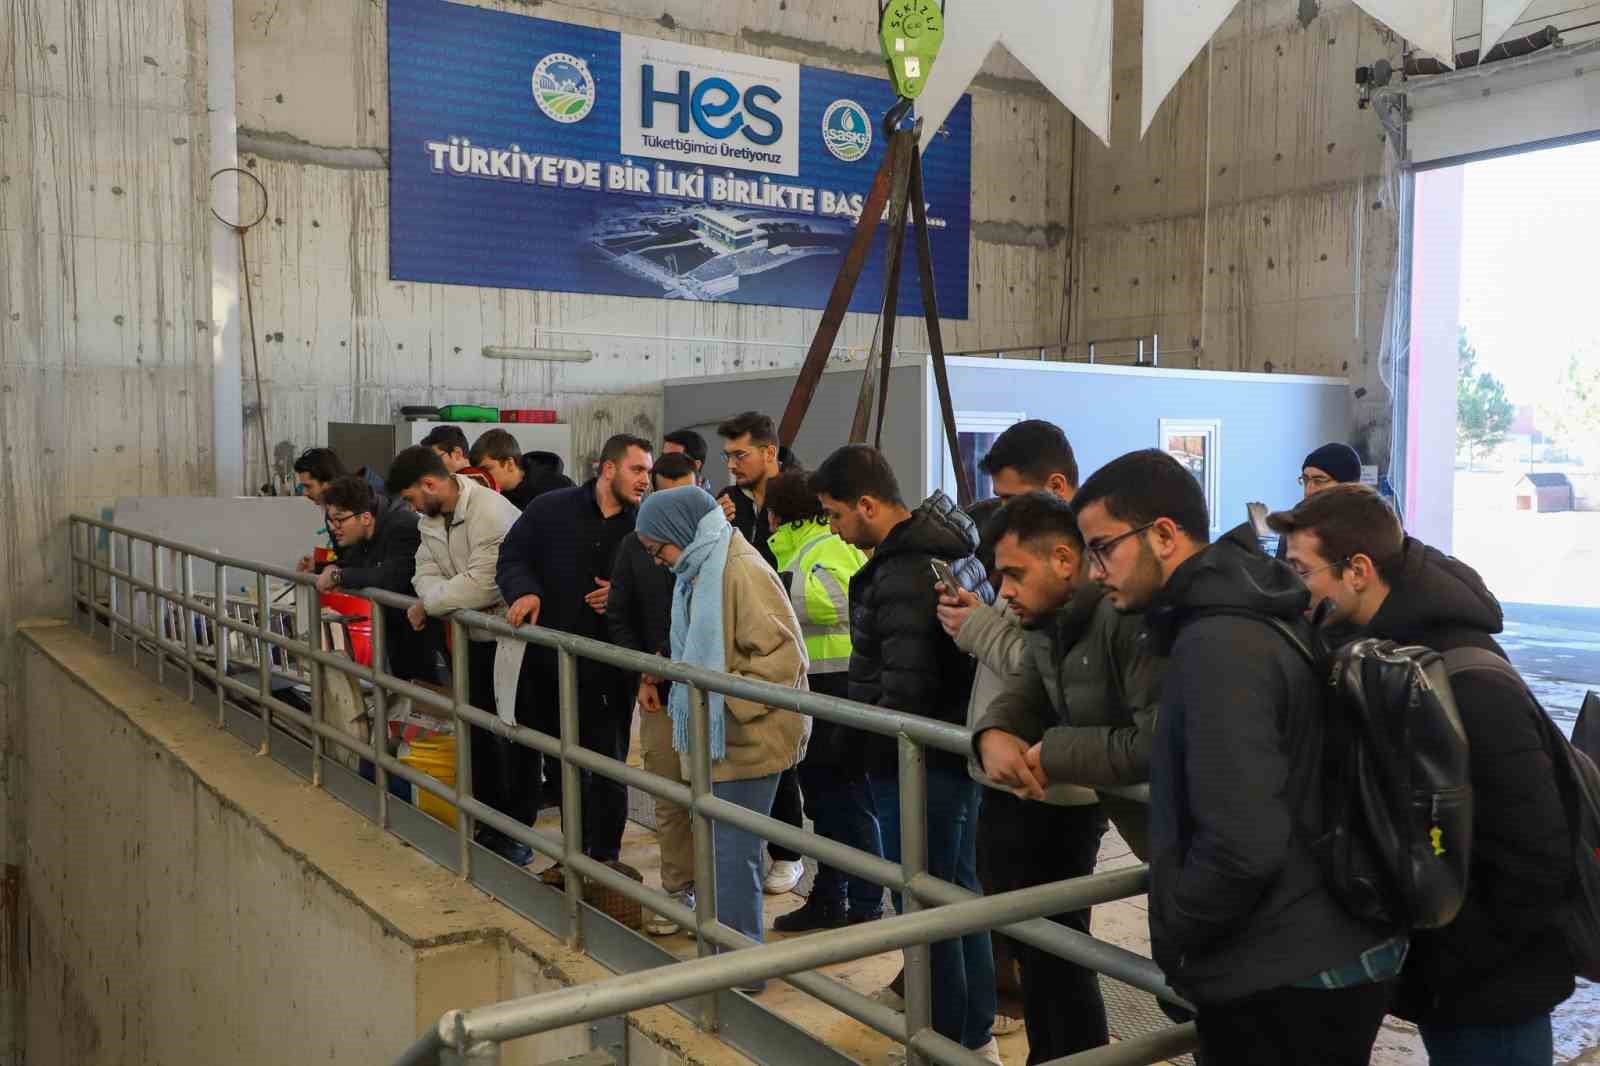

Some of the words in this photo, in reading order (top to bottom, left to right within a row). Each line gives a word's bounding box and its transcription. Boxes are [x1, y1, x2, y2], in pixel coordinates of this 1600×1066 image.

[642, 134, 718, 155] Tükettiğimizi
[720, 142, 782, 164] Üretiyoruz
[607, 159, 650, 193] BİR
[656, 163, 705, 198] İLKİ
[711, 172, 816, 212] BİRLİKTE
